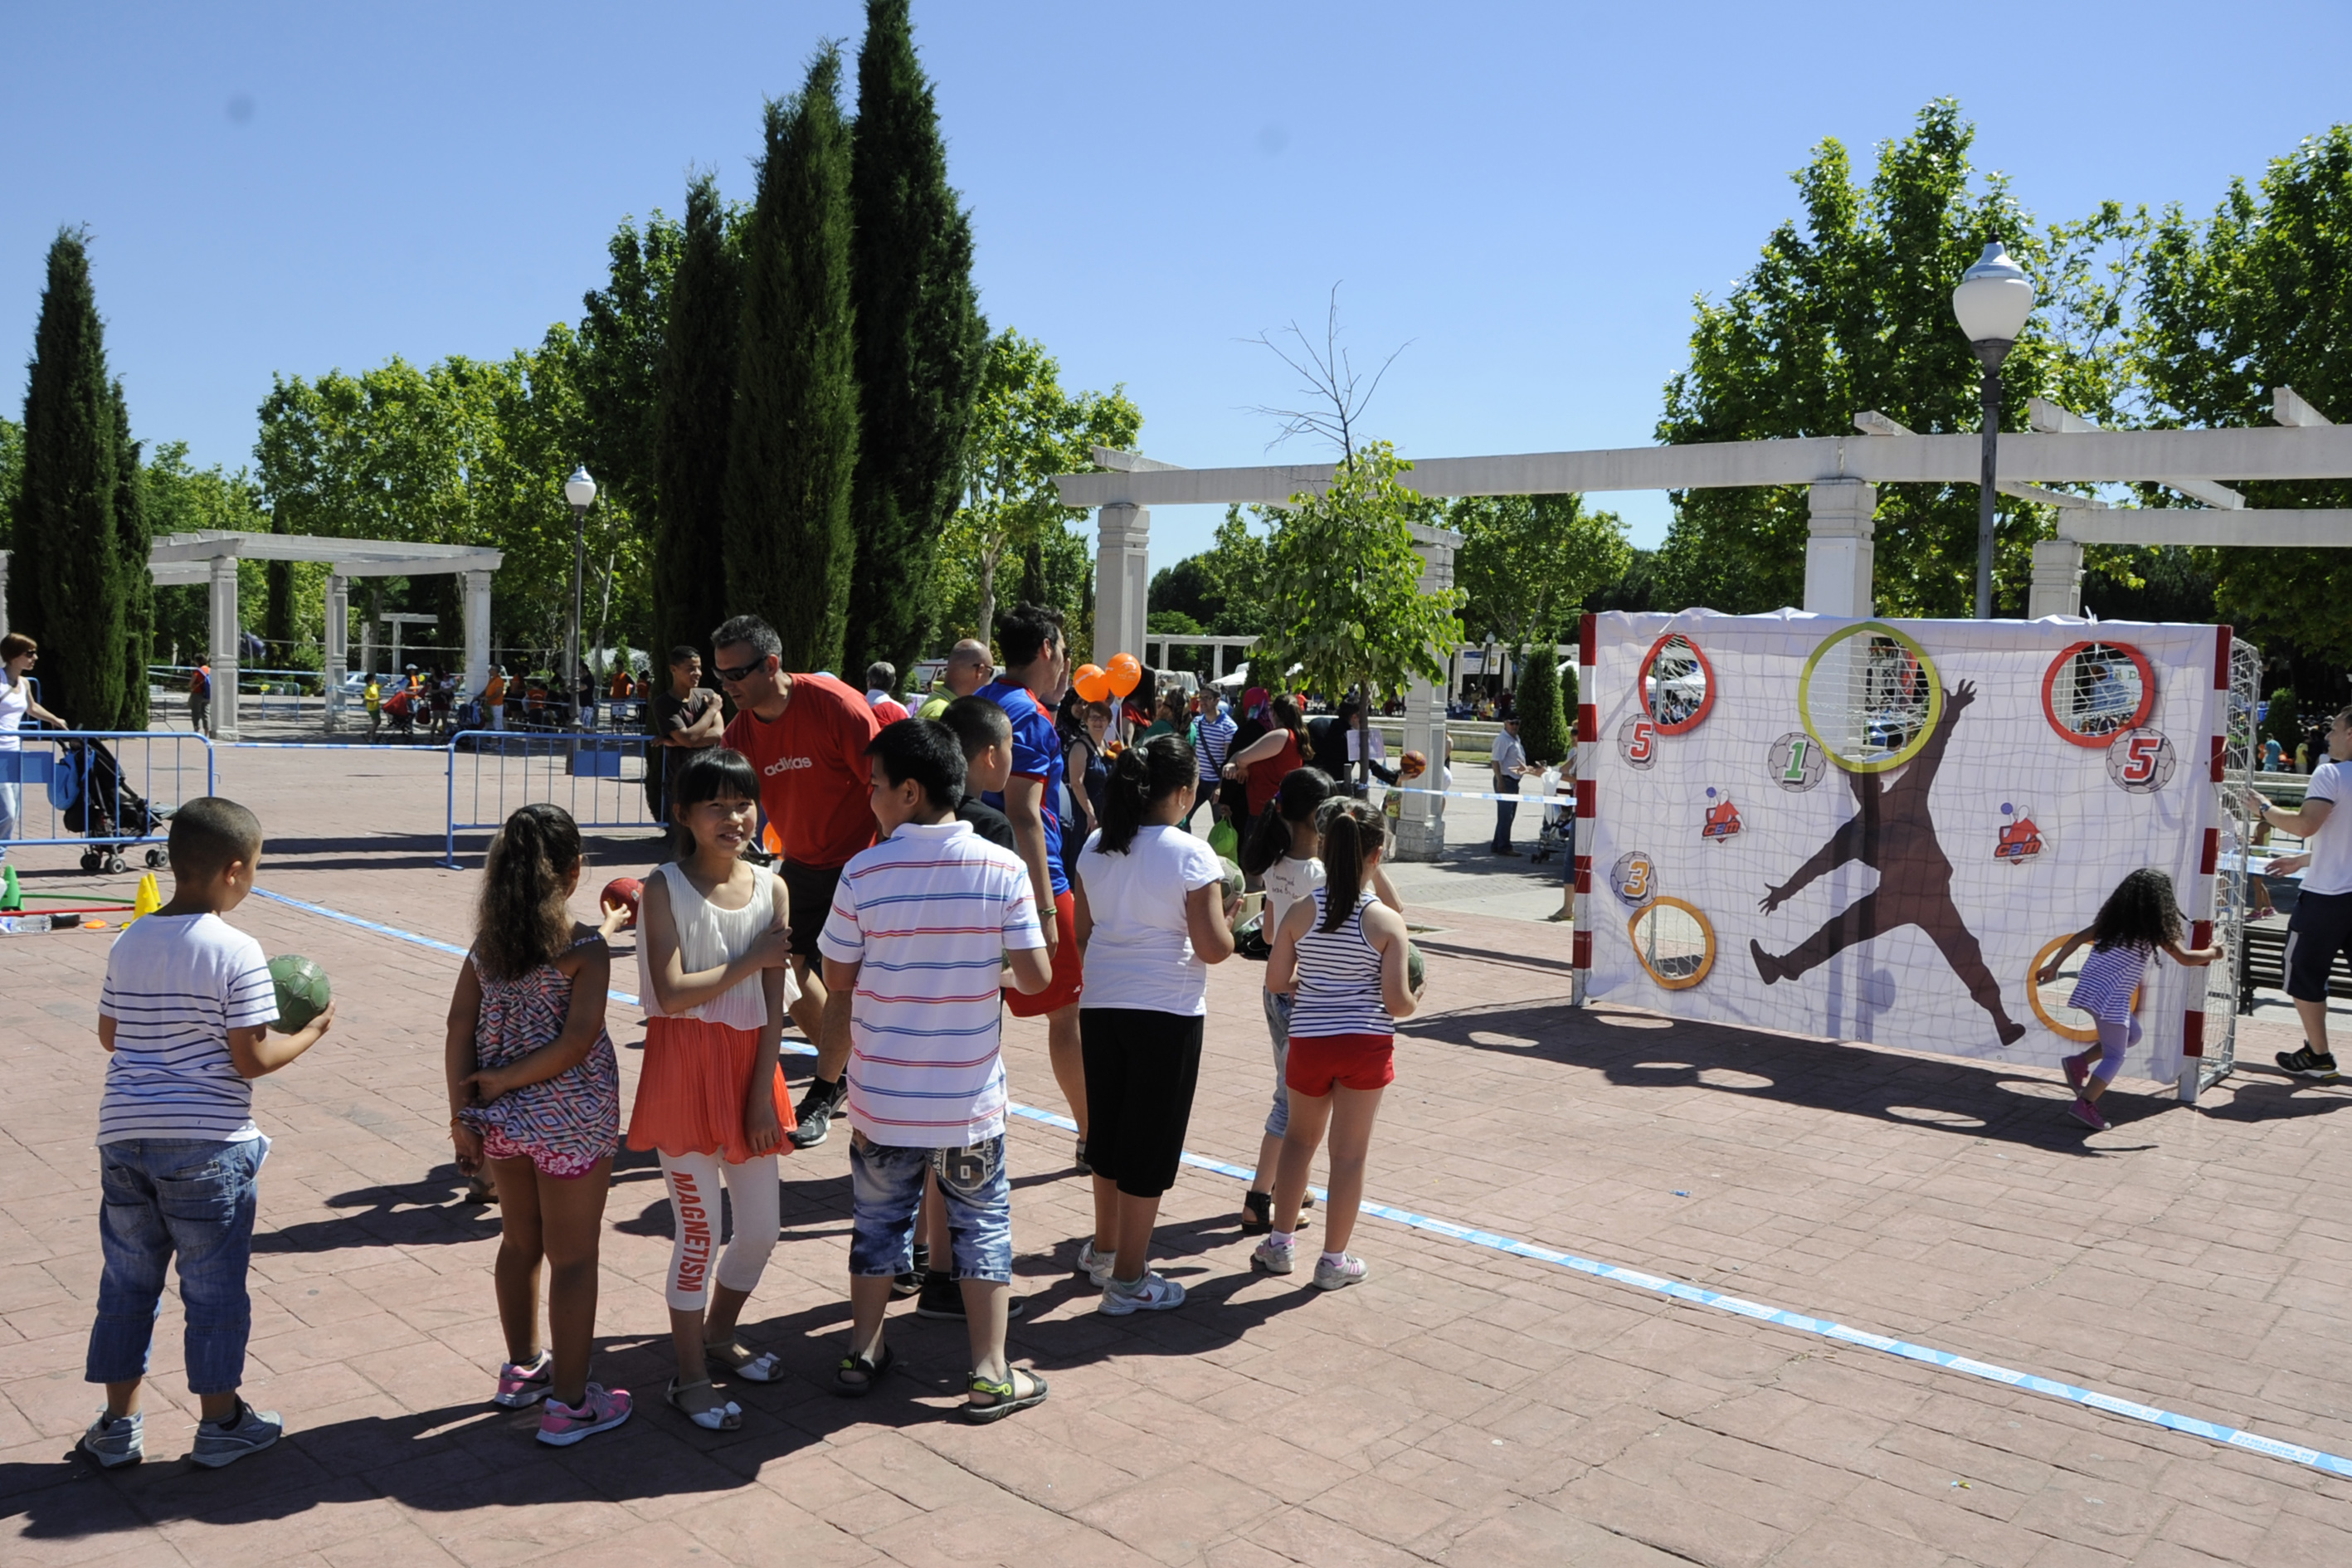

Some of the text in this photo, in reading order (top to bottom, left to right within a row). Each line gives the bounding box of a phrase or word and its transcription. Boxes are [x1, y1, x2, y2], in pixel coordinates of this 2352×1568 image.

[1629, 721, 1653, 762] 5
[1782, 739, 1809, 785] 1
[2121, 736, 2165, 786] 5
[763, 755, 813, 777] adidas
[1621, 859, 1651, 901] 3
[670, 1171, 712, 1293] MAGNETISM
